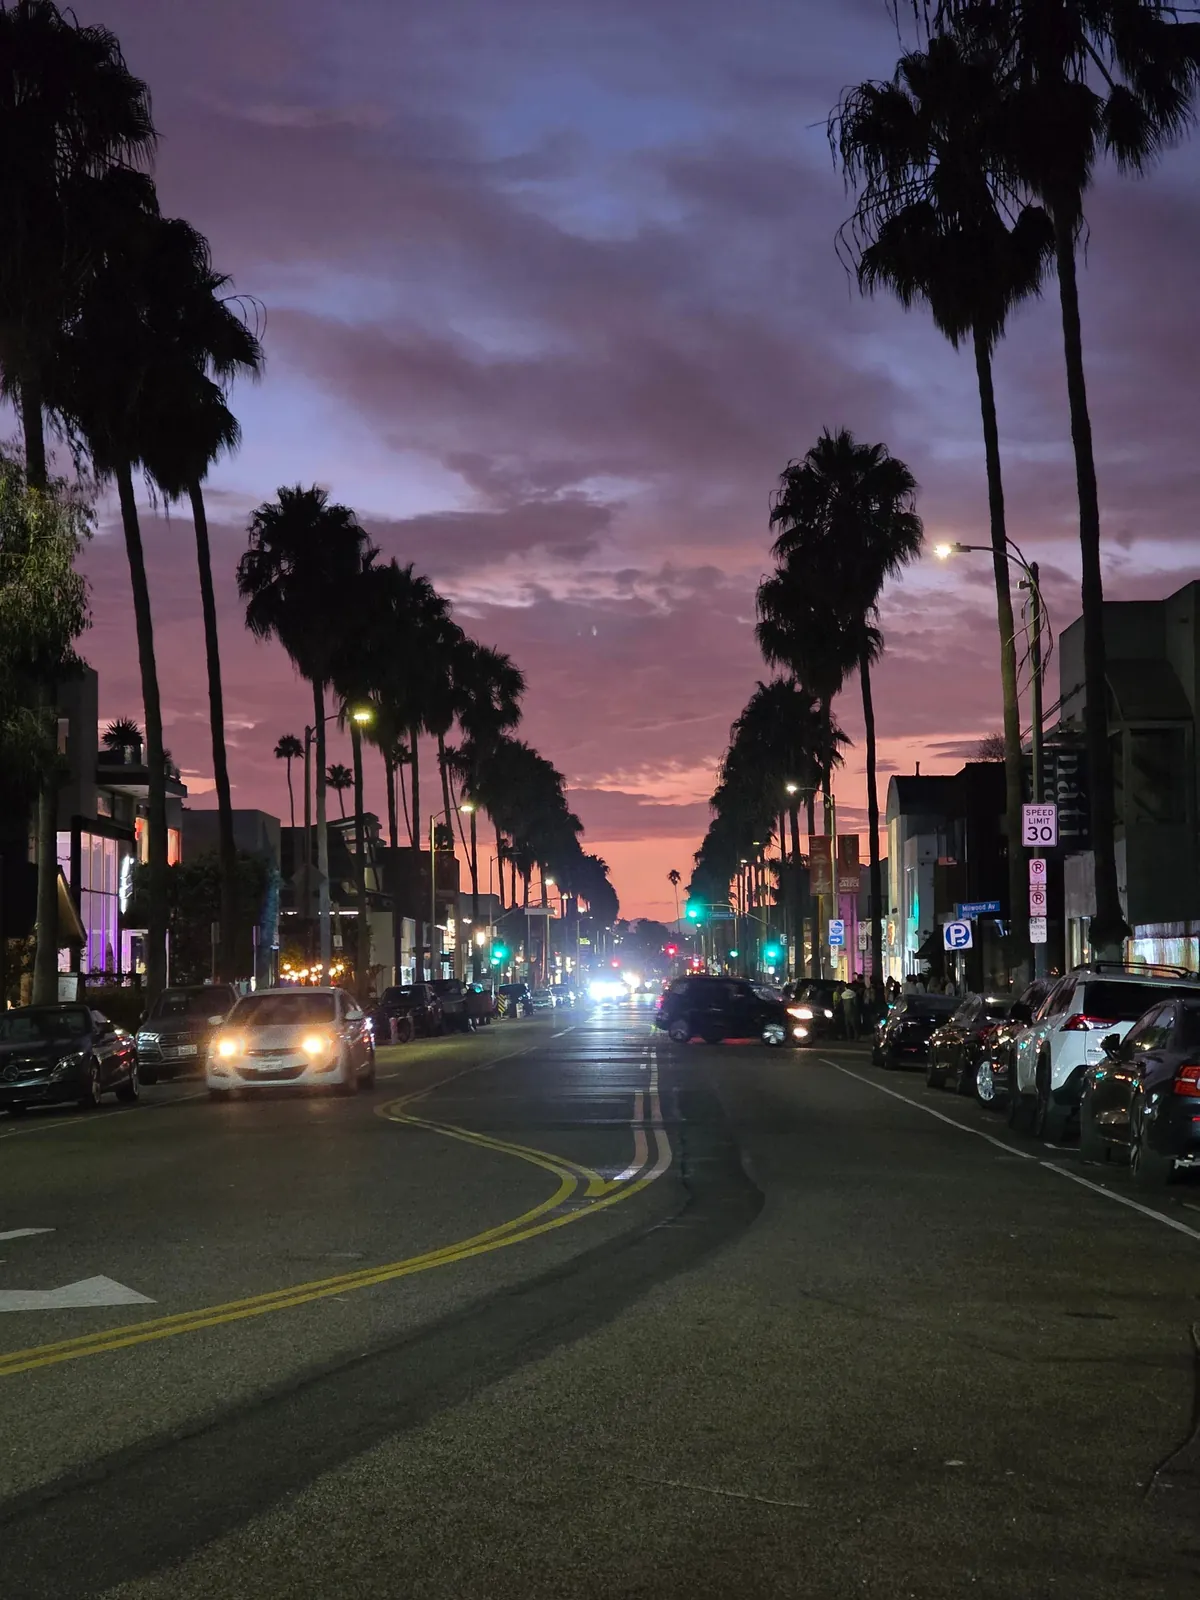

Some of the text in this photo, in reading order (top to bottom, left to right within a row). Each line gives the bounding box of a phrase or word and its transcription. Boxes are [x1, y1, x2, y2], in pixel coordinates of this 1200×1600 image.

[1027, 826, 1053, 841] 30
[962, 904, 986, 912] Milwood
[949, 925, 967, 945] P
